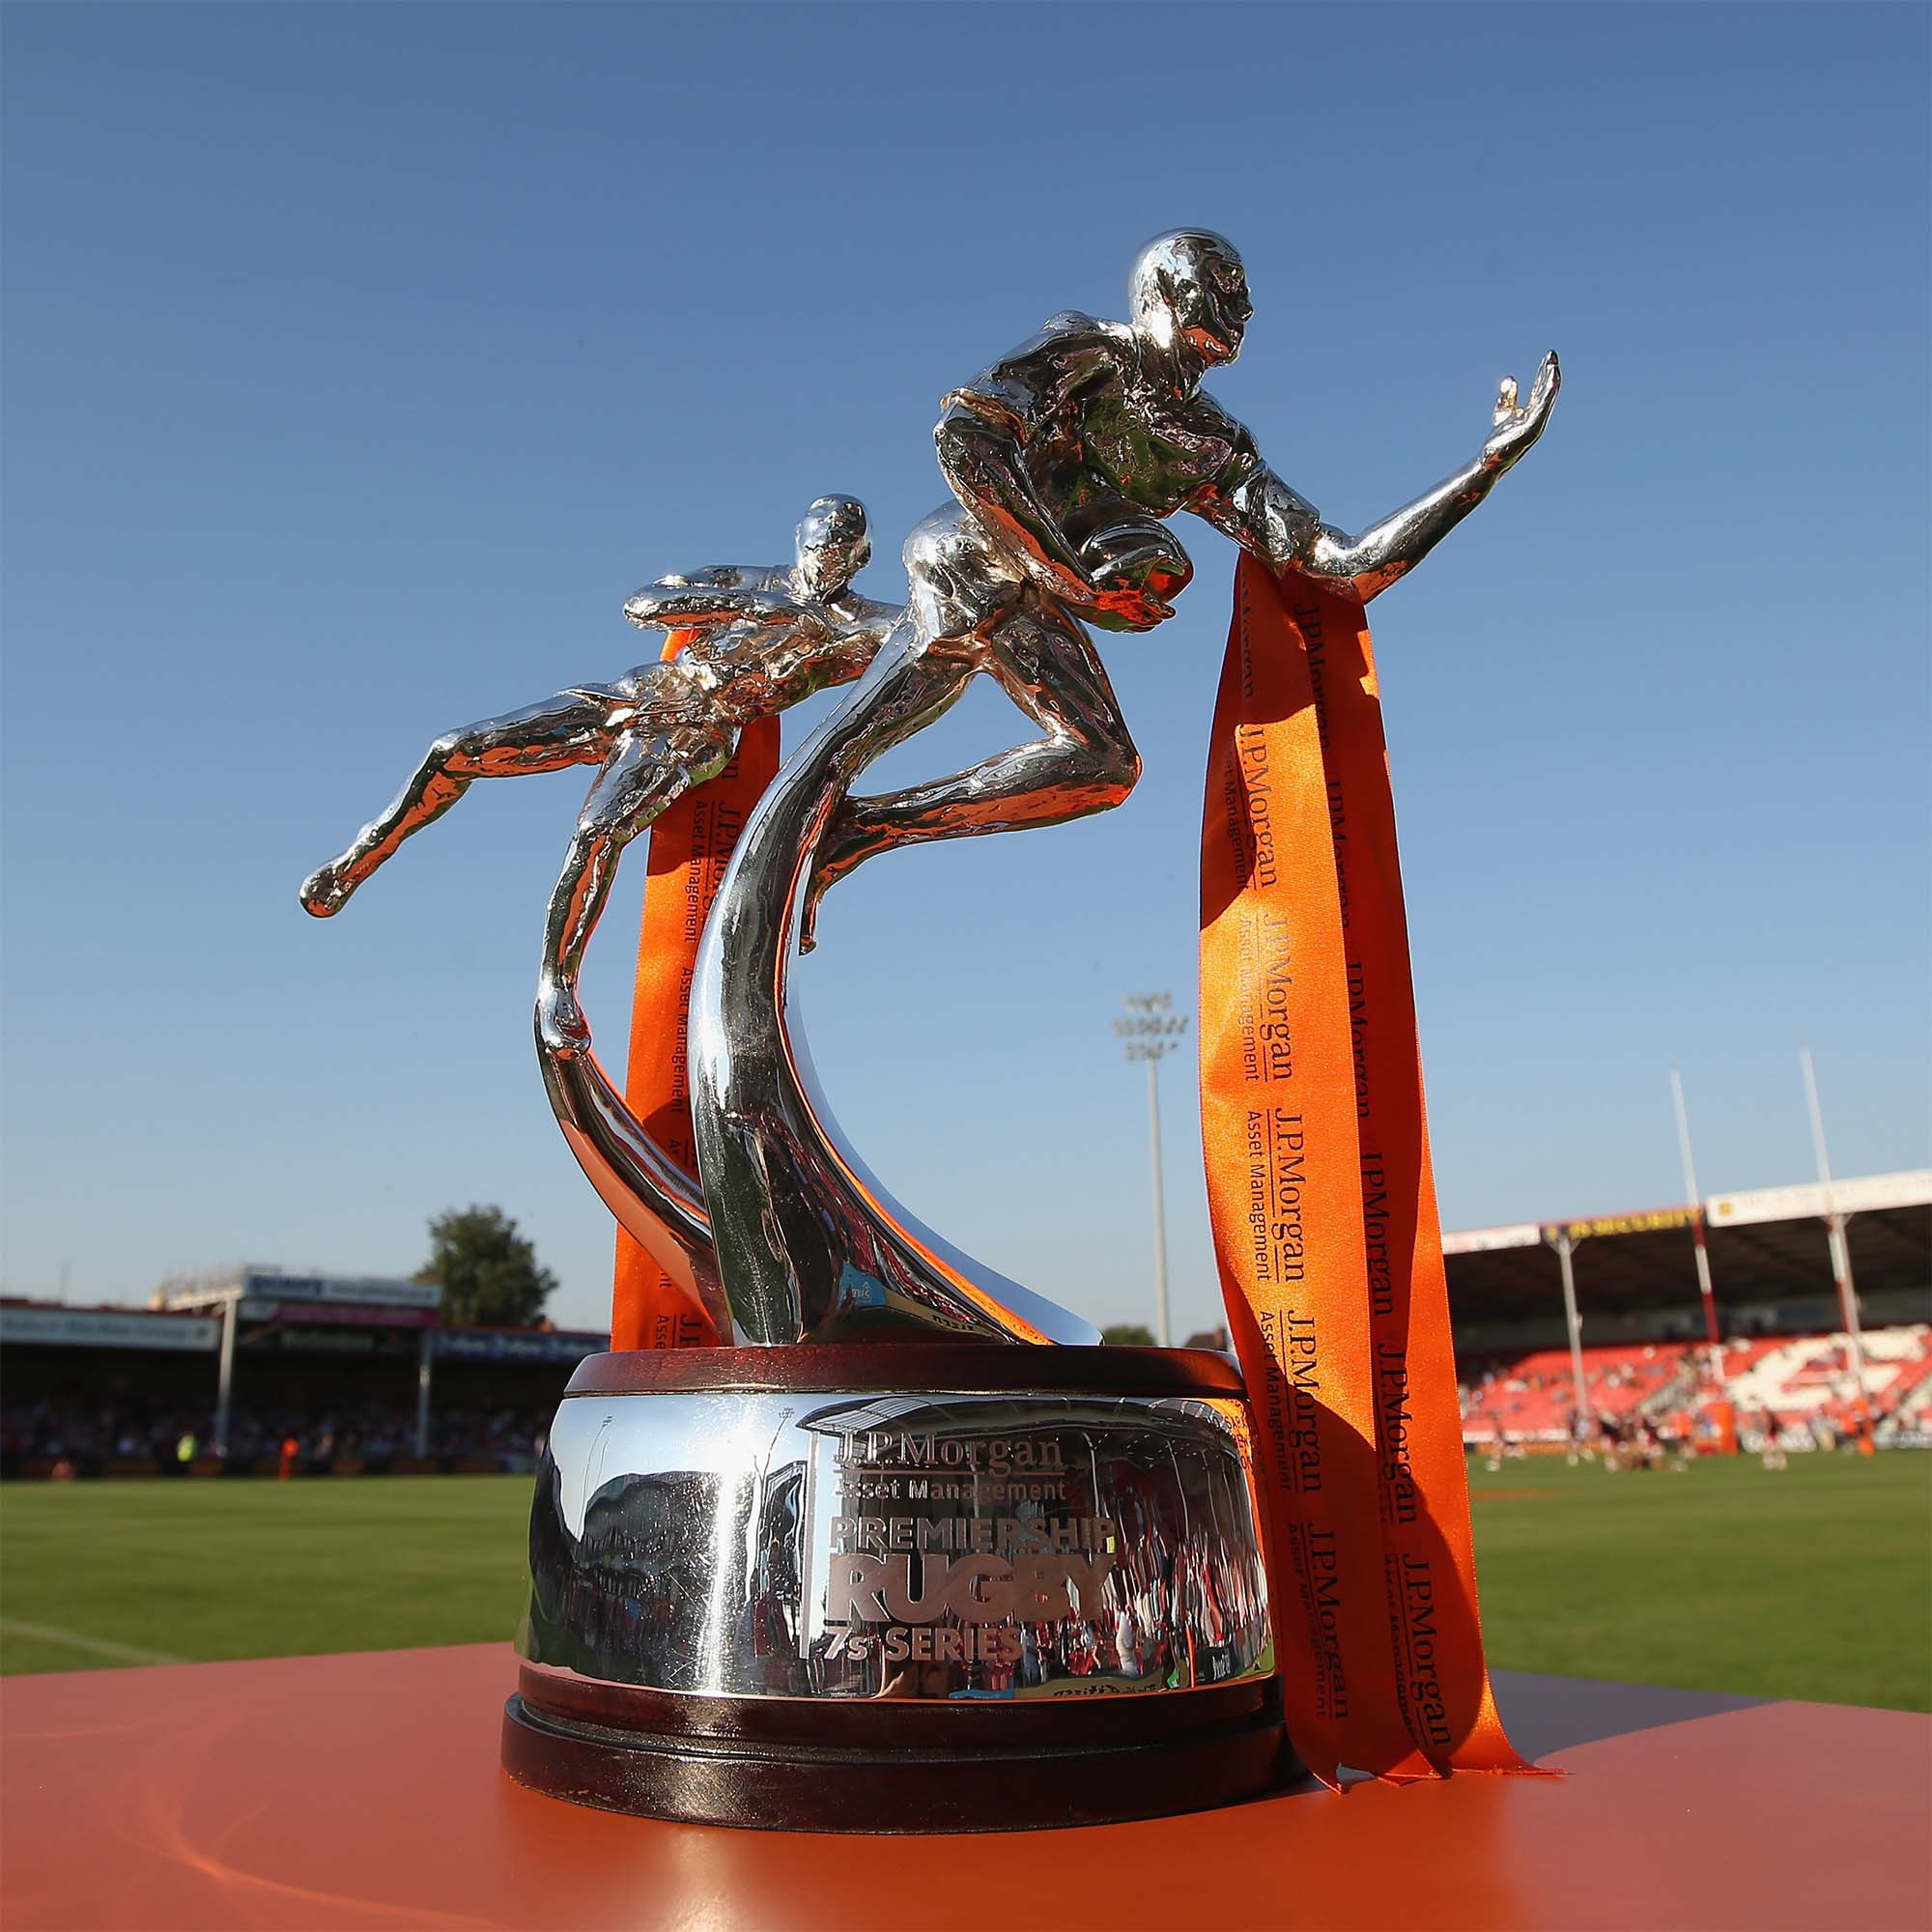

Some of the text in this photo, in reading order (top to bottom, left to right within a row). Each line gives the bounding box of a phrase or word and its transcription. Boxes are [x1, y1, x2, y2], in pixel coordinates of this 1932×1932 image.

[684, 800, 709, 944] Asset Management
[1224, 780, 1249, 890] Management
[1239, 724, 1278, 888] J.P.Morgan
[671, 967, 695, 1114] Asset Management
[1237, 919, 1261, 1082] Asset Management
[1259, 912, 1293, 1081] J.P.Morgan
[1247, 1110, 1272, 1281] Asset Management
[1271, 1107, 1307, 1283] J.P.Morgan
[833, 1431, 1065, 1478] J.P.Morgan
[1259, 1310, 1293, 1491] Asset Management
[1287, 1310, 1321, 1492] J.P.Morgan
[1376, 1344, 1417, 1523] J.P.Morgan
[828, 1516, 1117, 1549] PREMIERSHIP
[833, 1479, 1066, 1501] Asset Management
[824, 1552, 1118, 1624] RUGBY
[824, 1628, 1021, 1662] 7s SERIES
[1307, 1522, 1349, 1719] J.P.Morgan
[1403, 1552, 1451, 1747] J.P.Morgan
